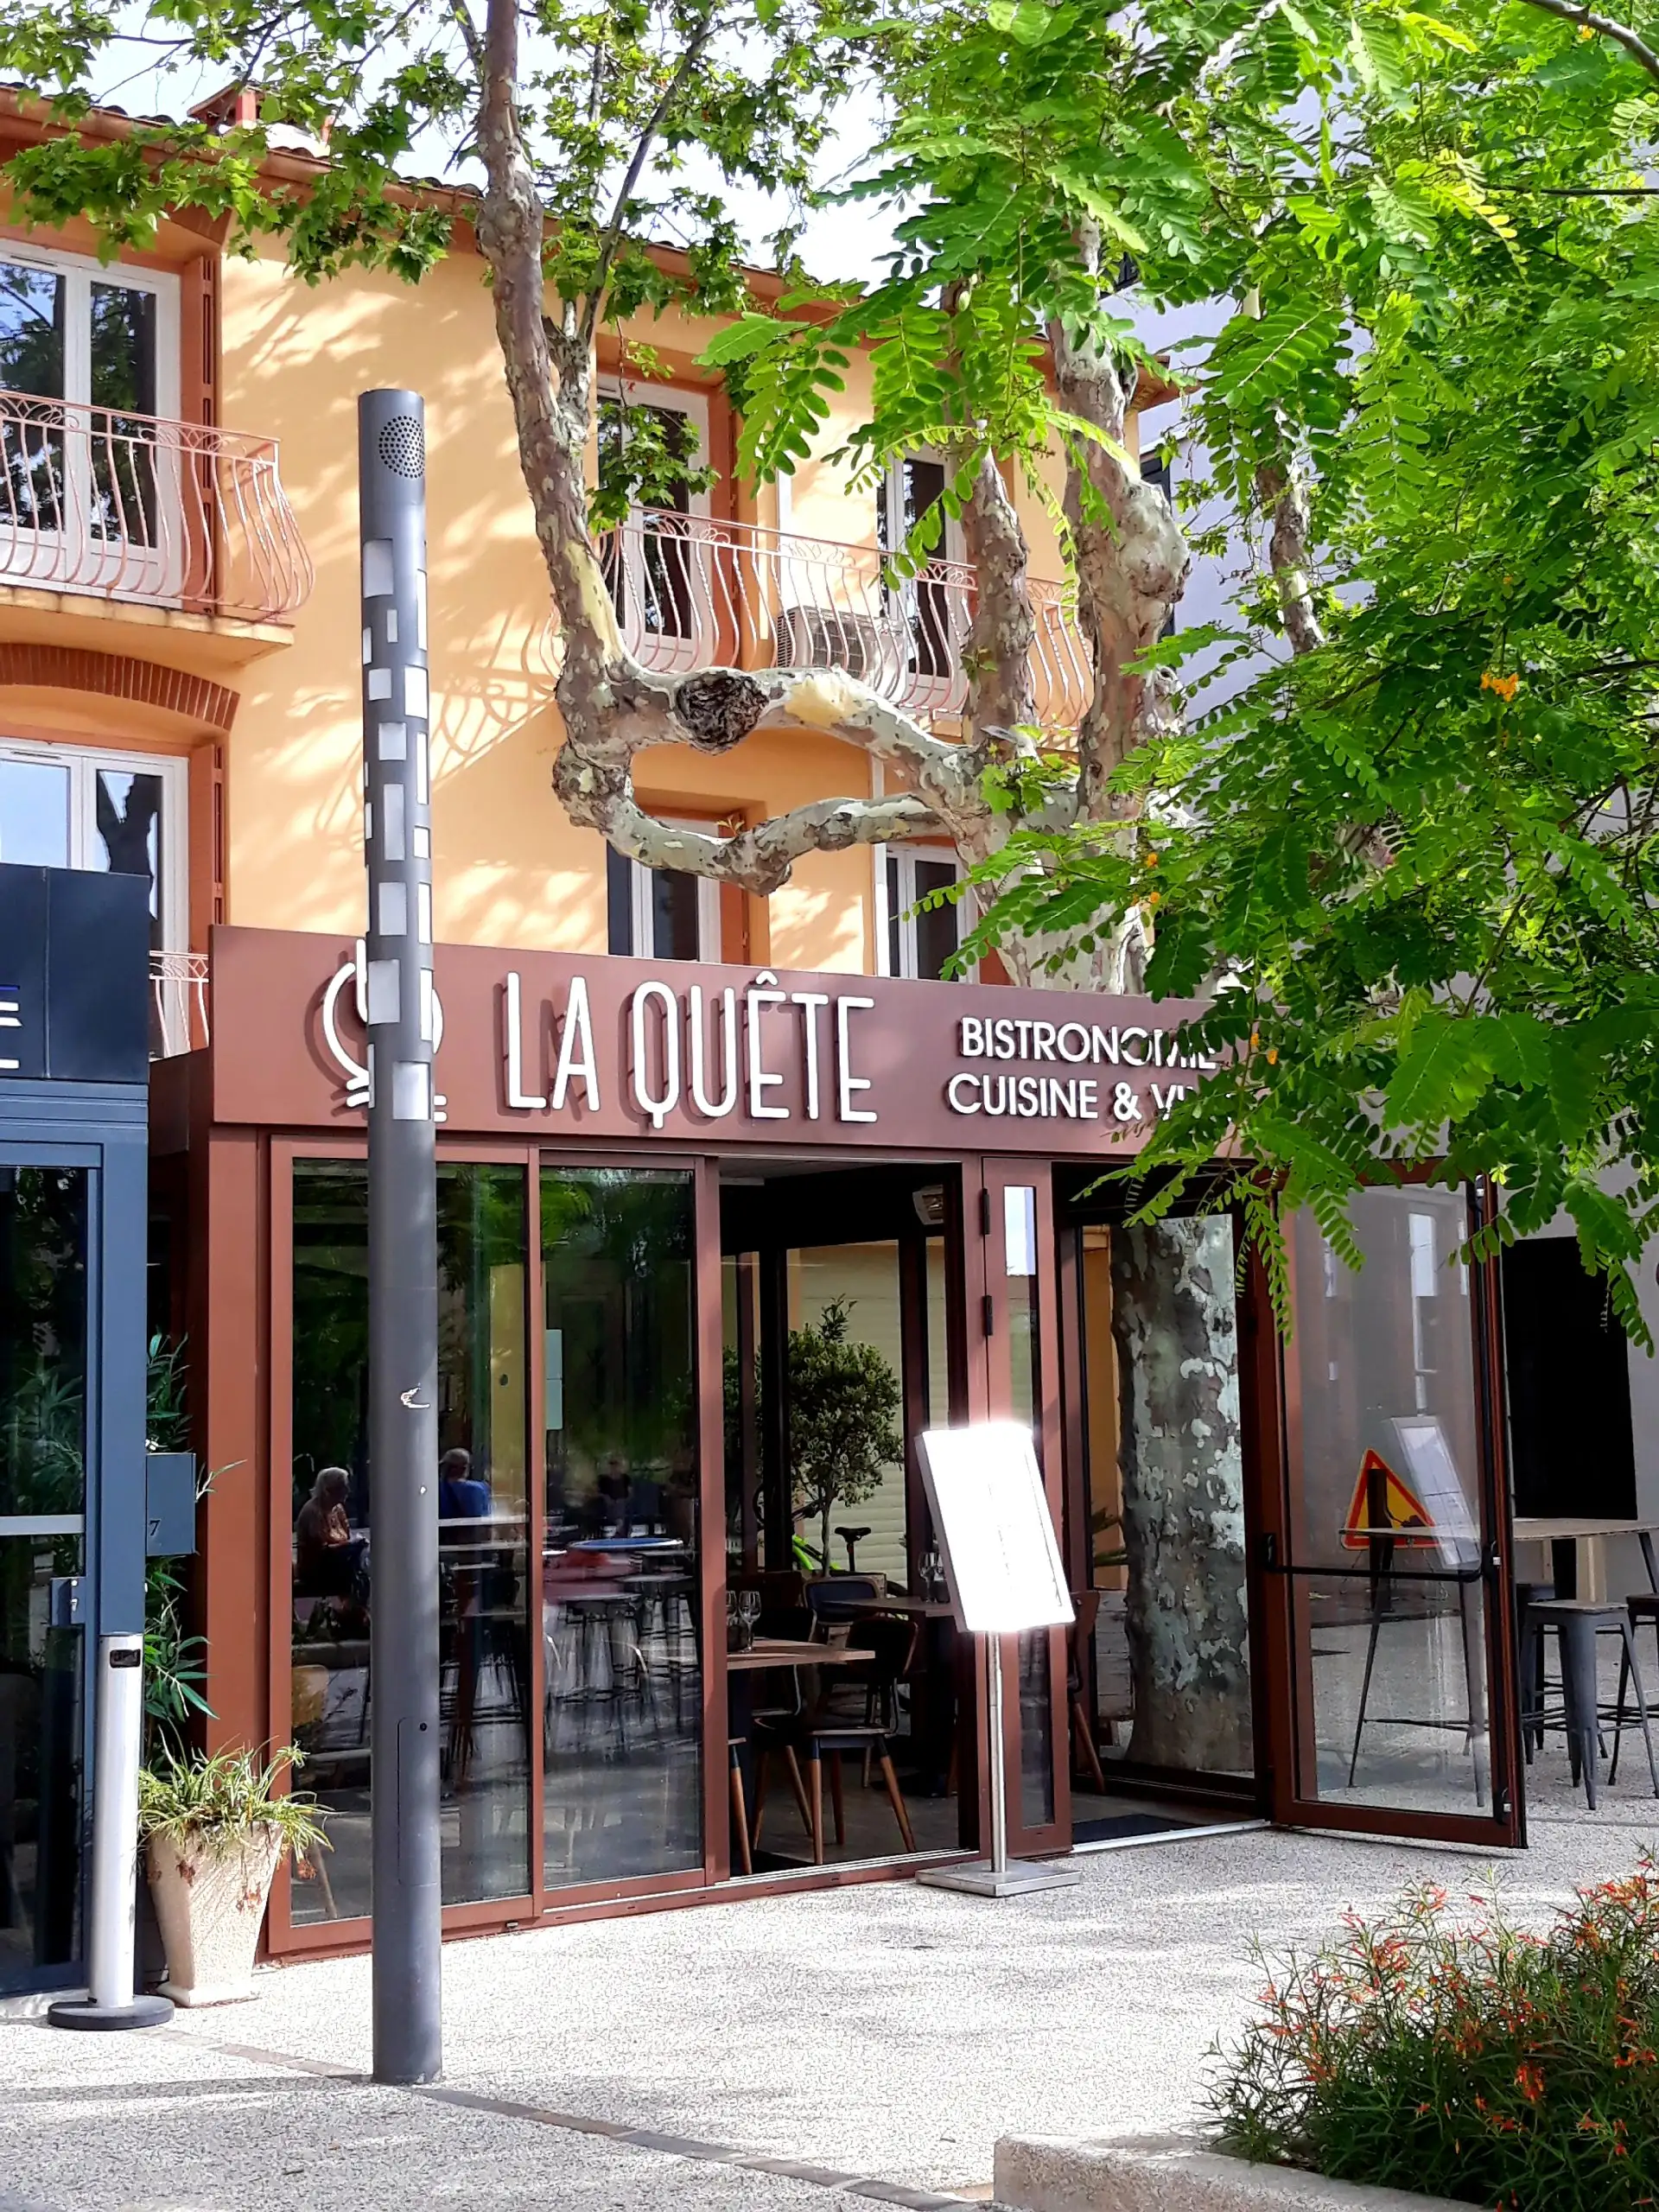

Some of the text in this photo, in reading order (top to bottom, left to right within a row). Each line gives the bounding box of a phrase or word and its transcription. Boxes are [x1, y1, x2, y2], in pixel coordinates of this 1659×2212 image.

[507, 970, 878, 1129] LA QUÊTE
[948, 1072, 1098, 1119] CUISINE
[1113, 1082, 1142, 1122] &
[149, 1519, 161, 1536] 7
